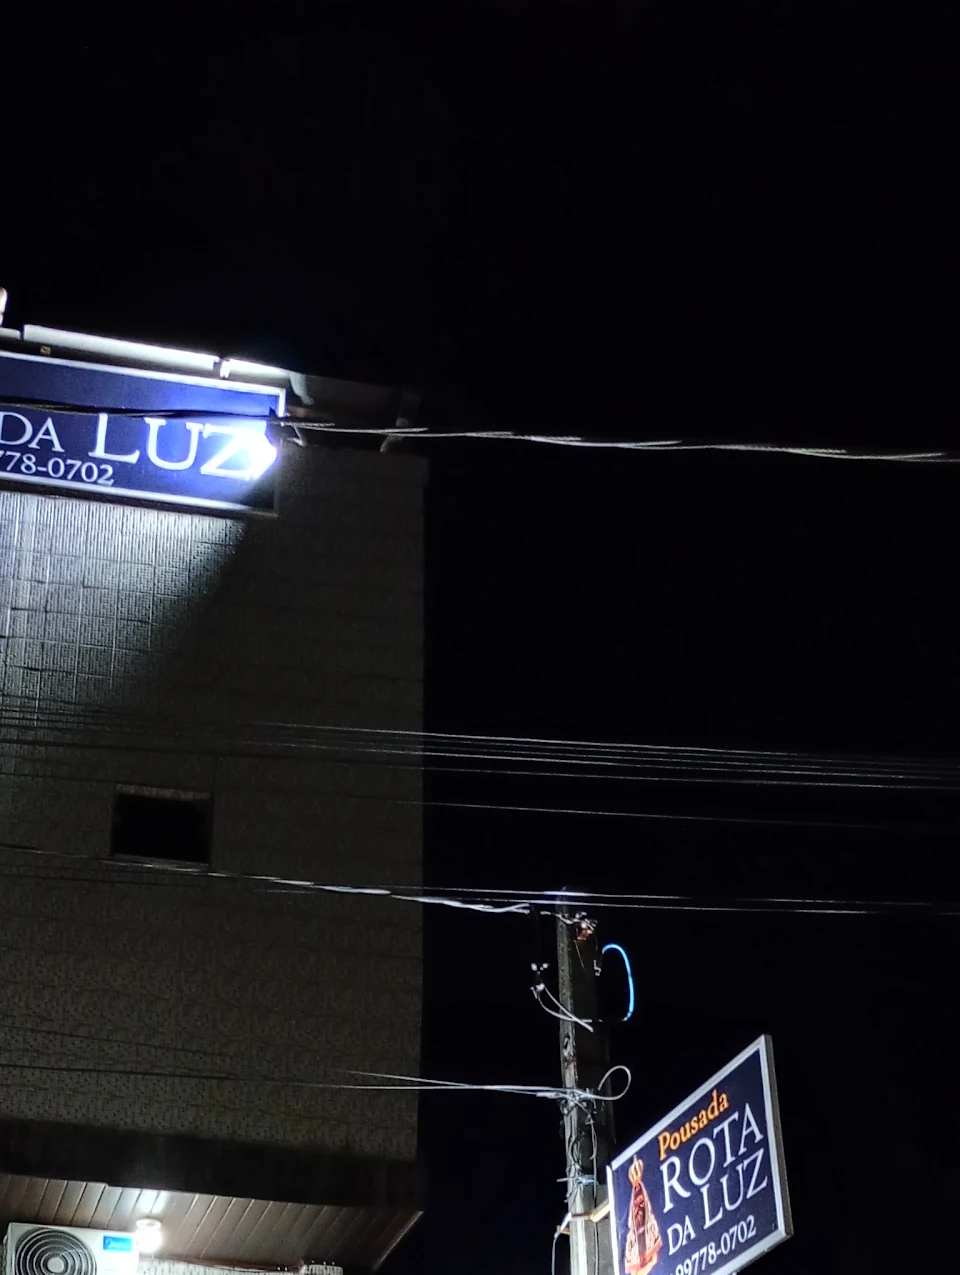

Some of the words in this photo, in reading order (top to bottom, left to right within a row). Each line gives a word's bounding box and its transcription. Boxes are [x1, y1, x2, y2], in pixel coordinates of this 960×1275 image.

[88, 412, 277, 482] LUZ
[657, 1088, 730, 1161] Pousada
[659, 1102, 765, 1214] ROTA
[666, 1214, 697, 1256] DA
[700, 1147, 769, 1231] LUZ
